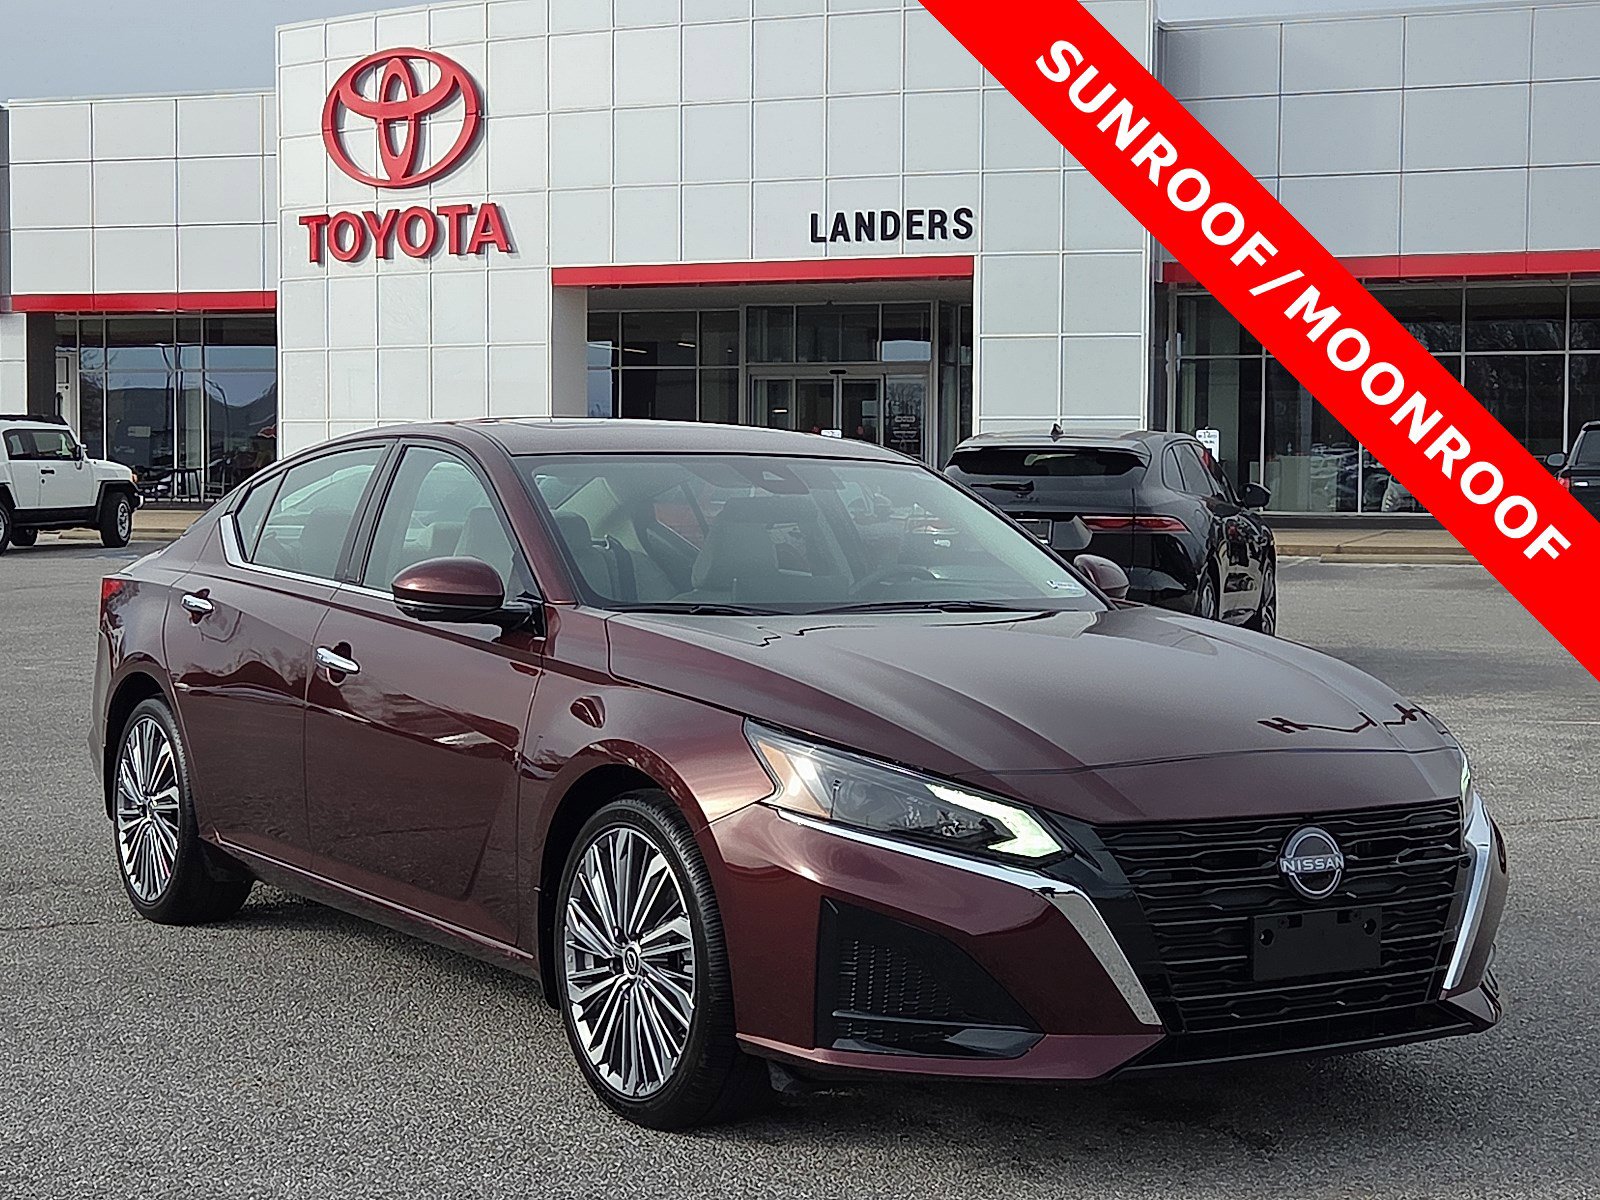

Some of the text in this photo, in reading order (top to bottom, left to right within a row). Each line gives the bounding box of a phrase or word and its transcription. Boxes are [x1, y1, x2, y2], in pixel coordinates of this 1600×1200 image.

[299, 203, 511, 263] TOYOTA
[810, 207, 973, 242] LANDERS
[1281, 856, 1344, 872] NISSAN
